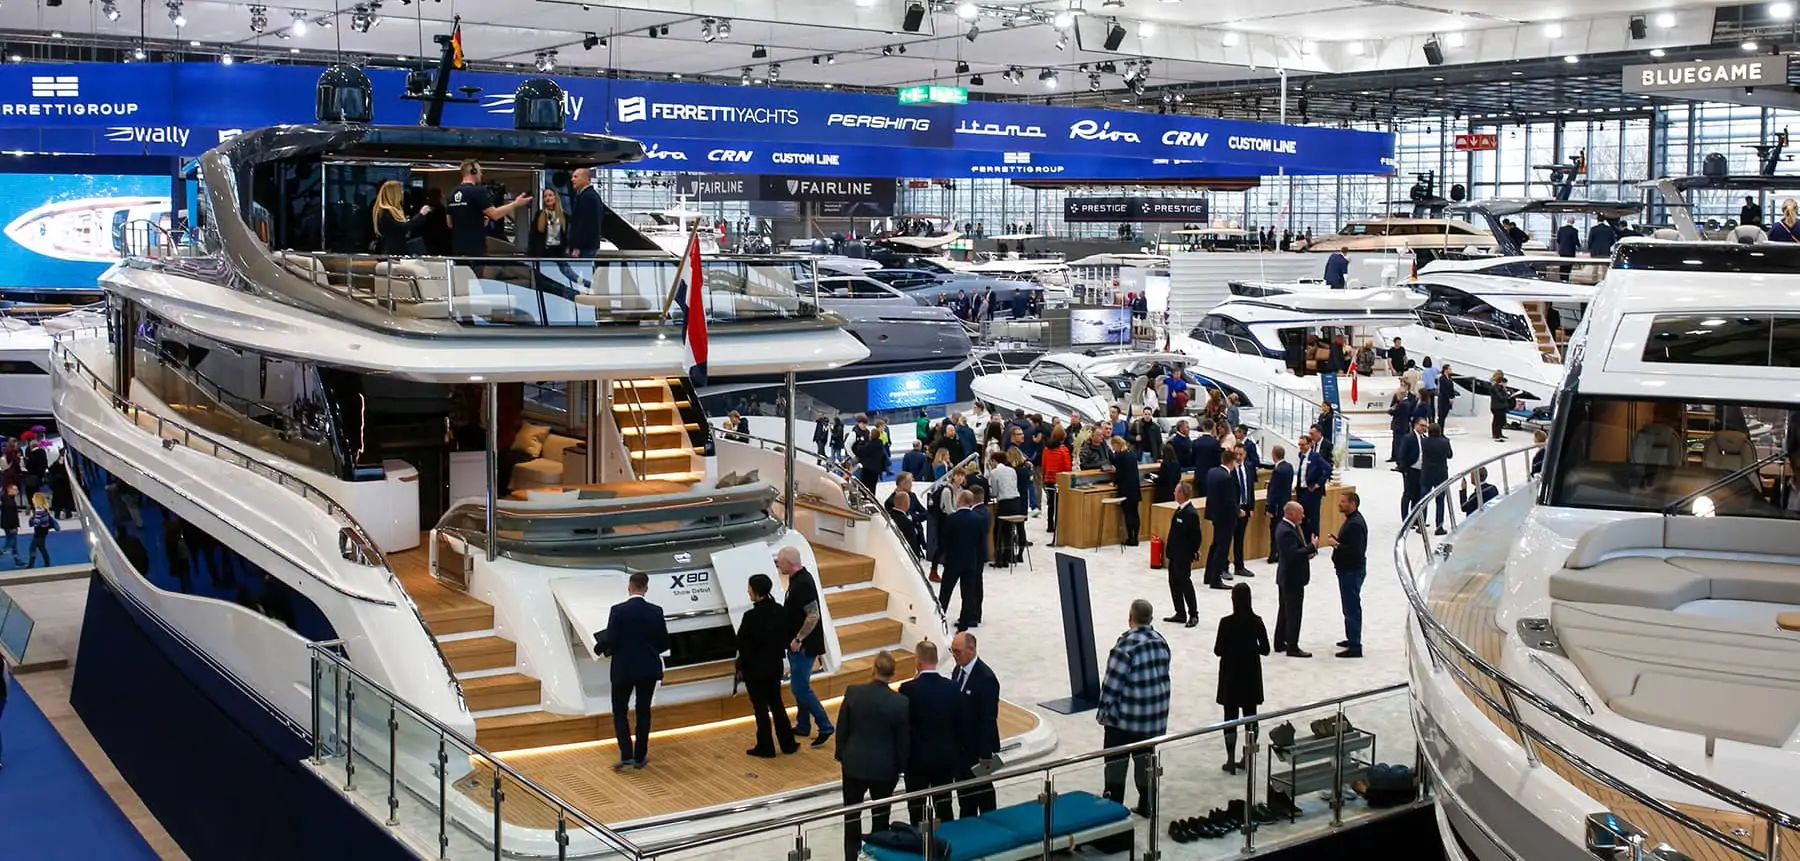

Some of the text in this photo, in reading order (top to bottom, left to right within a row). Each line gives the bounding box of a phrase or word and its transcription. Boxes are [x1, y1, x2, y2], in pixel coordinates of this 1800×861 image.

[1642, 63, 1762, 86] BLUEGAME
[0, 104, 138, 115] RRETTIGROUP
[827, 113, 930, 131] PERSHING
[135, 127, 190, 147] wally
[1069, 119, 1141, 143] Riva
[1161, 130, 1209, 147] CRN
[1228, 136, 1296, 153] CUSTOM LINE
[707, 149, 754, 163] CRN
[772, 152, 840, 166] CUSTOM LINE
[971, 165, 1065, 173] FERRETTIGROUP
[699, 180, 744, 194] FAIRLINE
[800, 181, 872, 195] FAIRLINE
[1081, 204, 1128, 213] PRESTIGE
[1154, 205, 1203, 214] PRESTIGE
